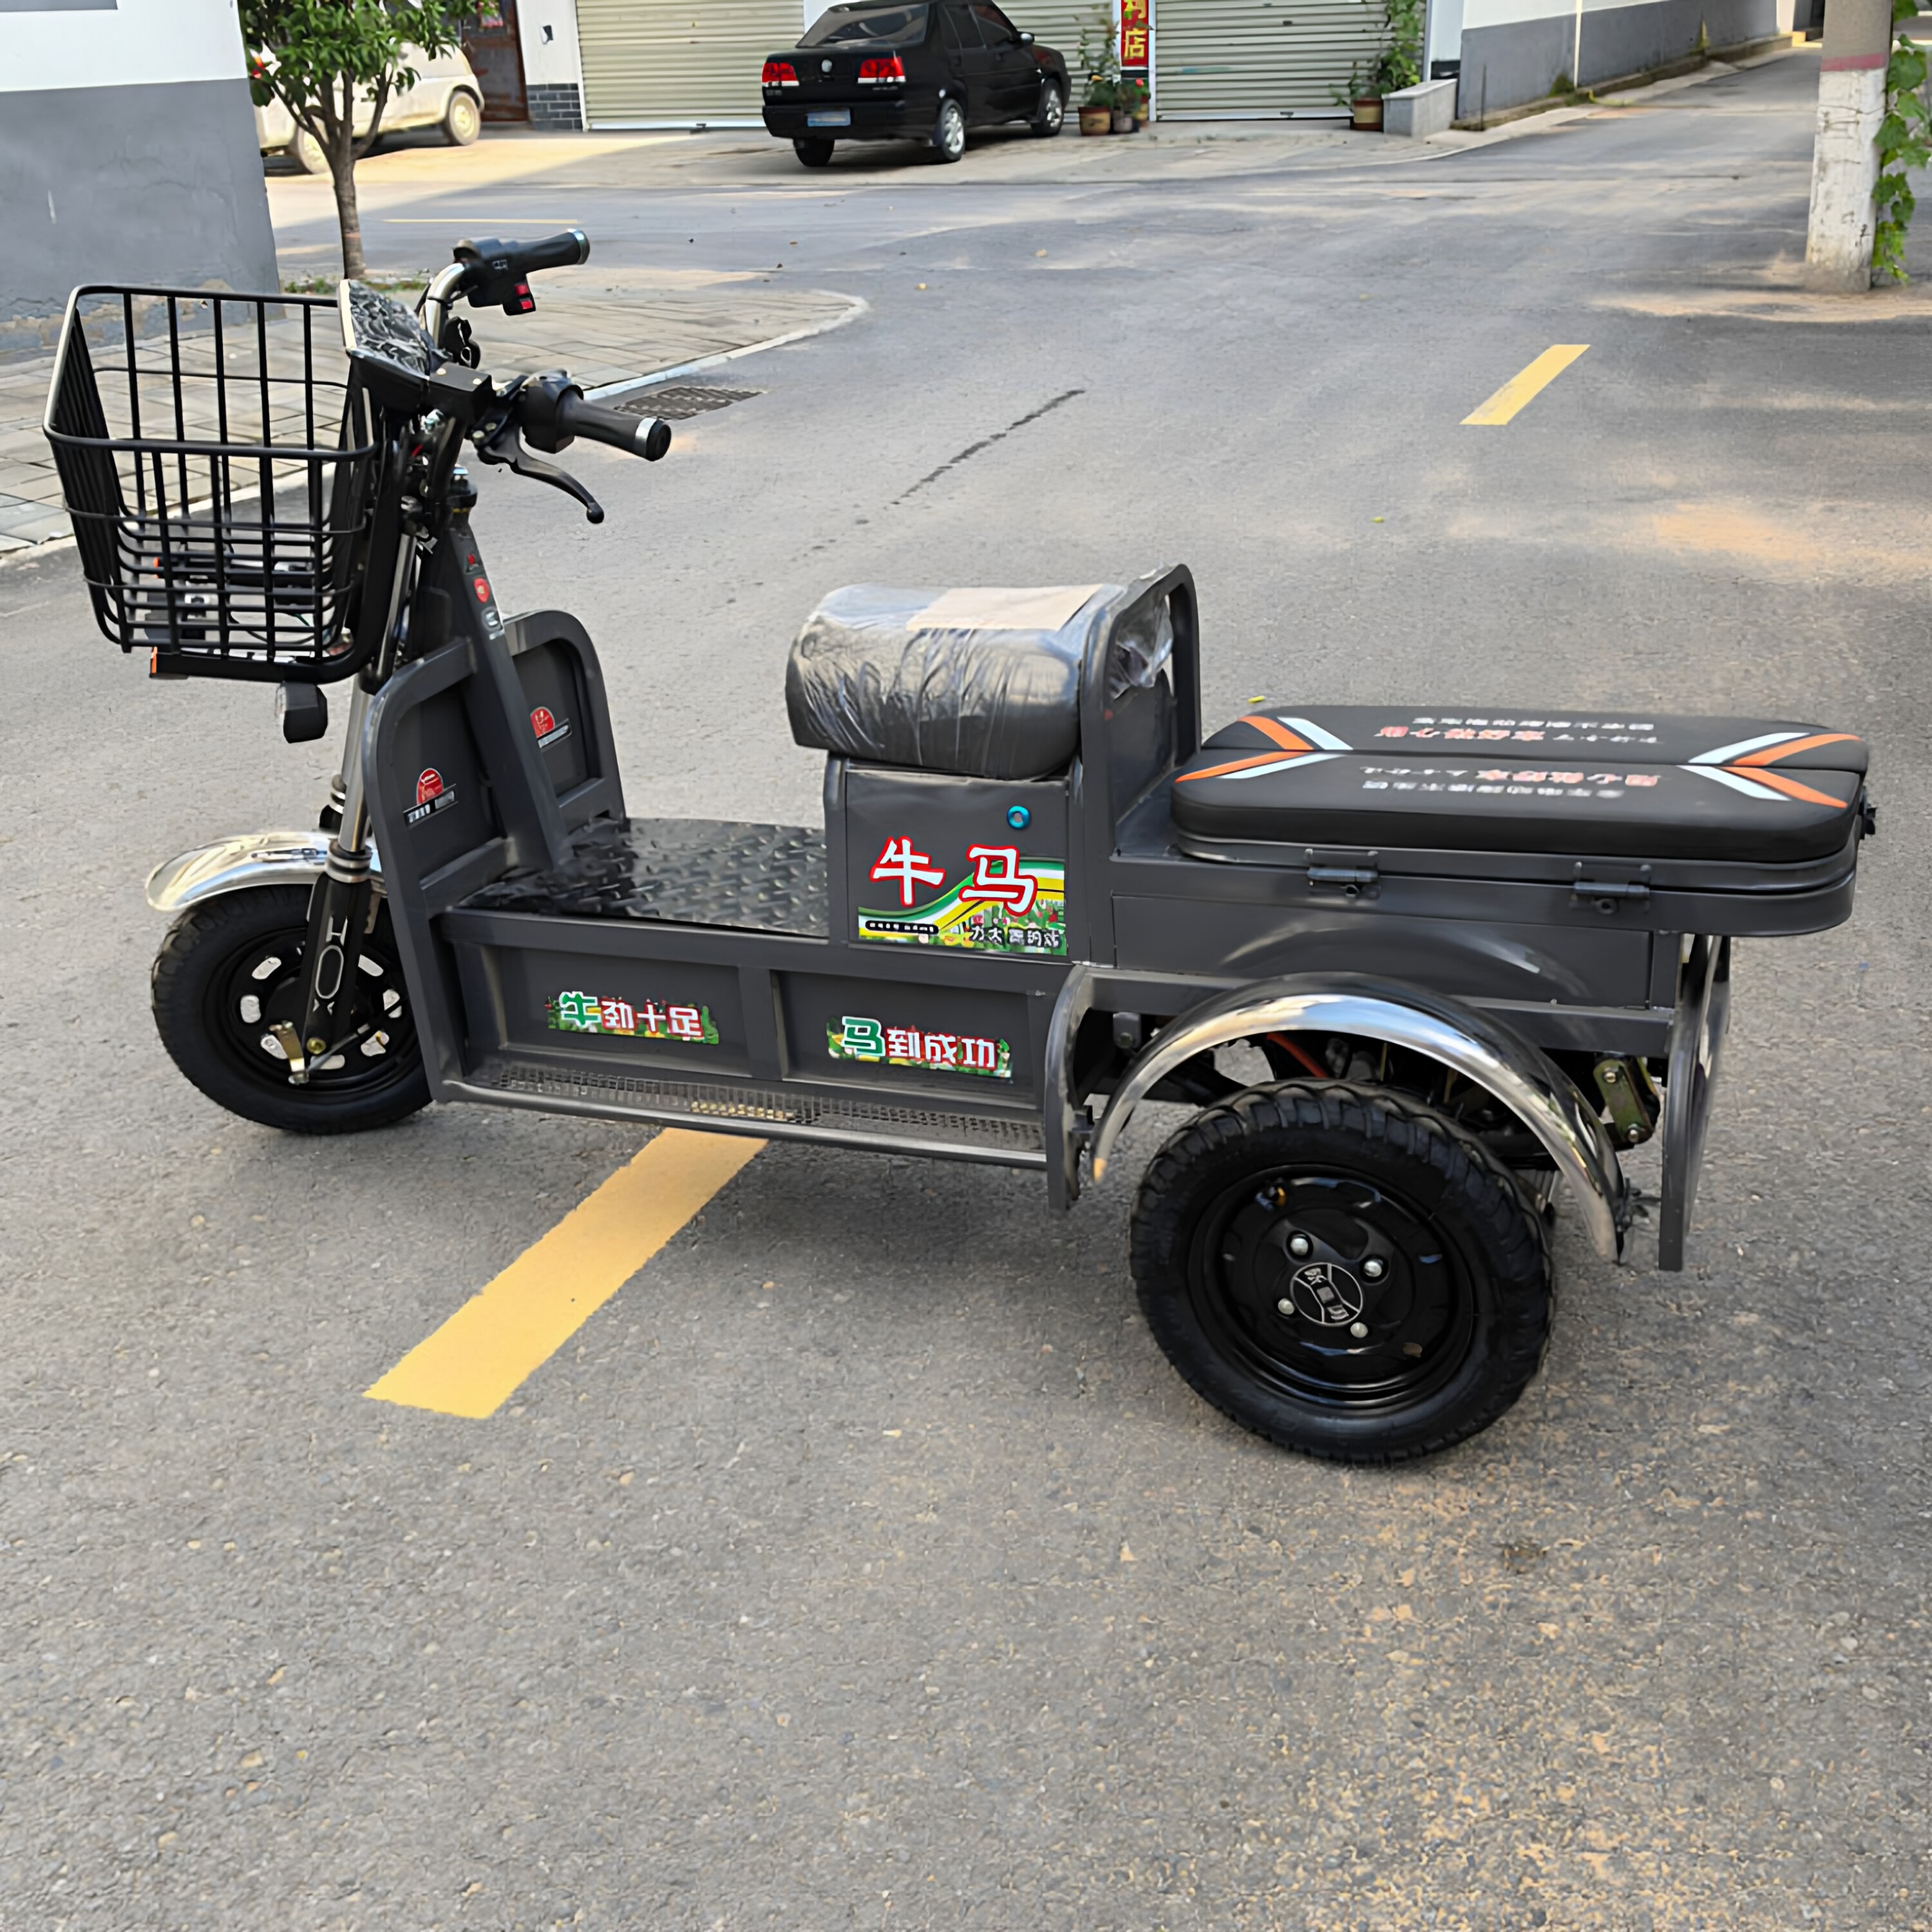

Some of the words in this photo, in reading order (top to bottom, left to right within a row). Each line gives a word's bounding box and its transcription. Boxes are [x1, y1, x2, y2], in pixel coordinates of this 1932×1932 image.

[869, 835, 1038, 916] 牛马
[559, 991, 702, 1037] 牛劲十足
[841, 1016, 996, 1068] 马到成功
